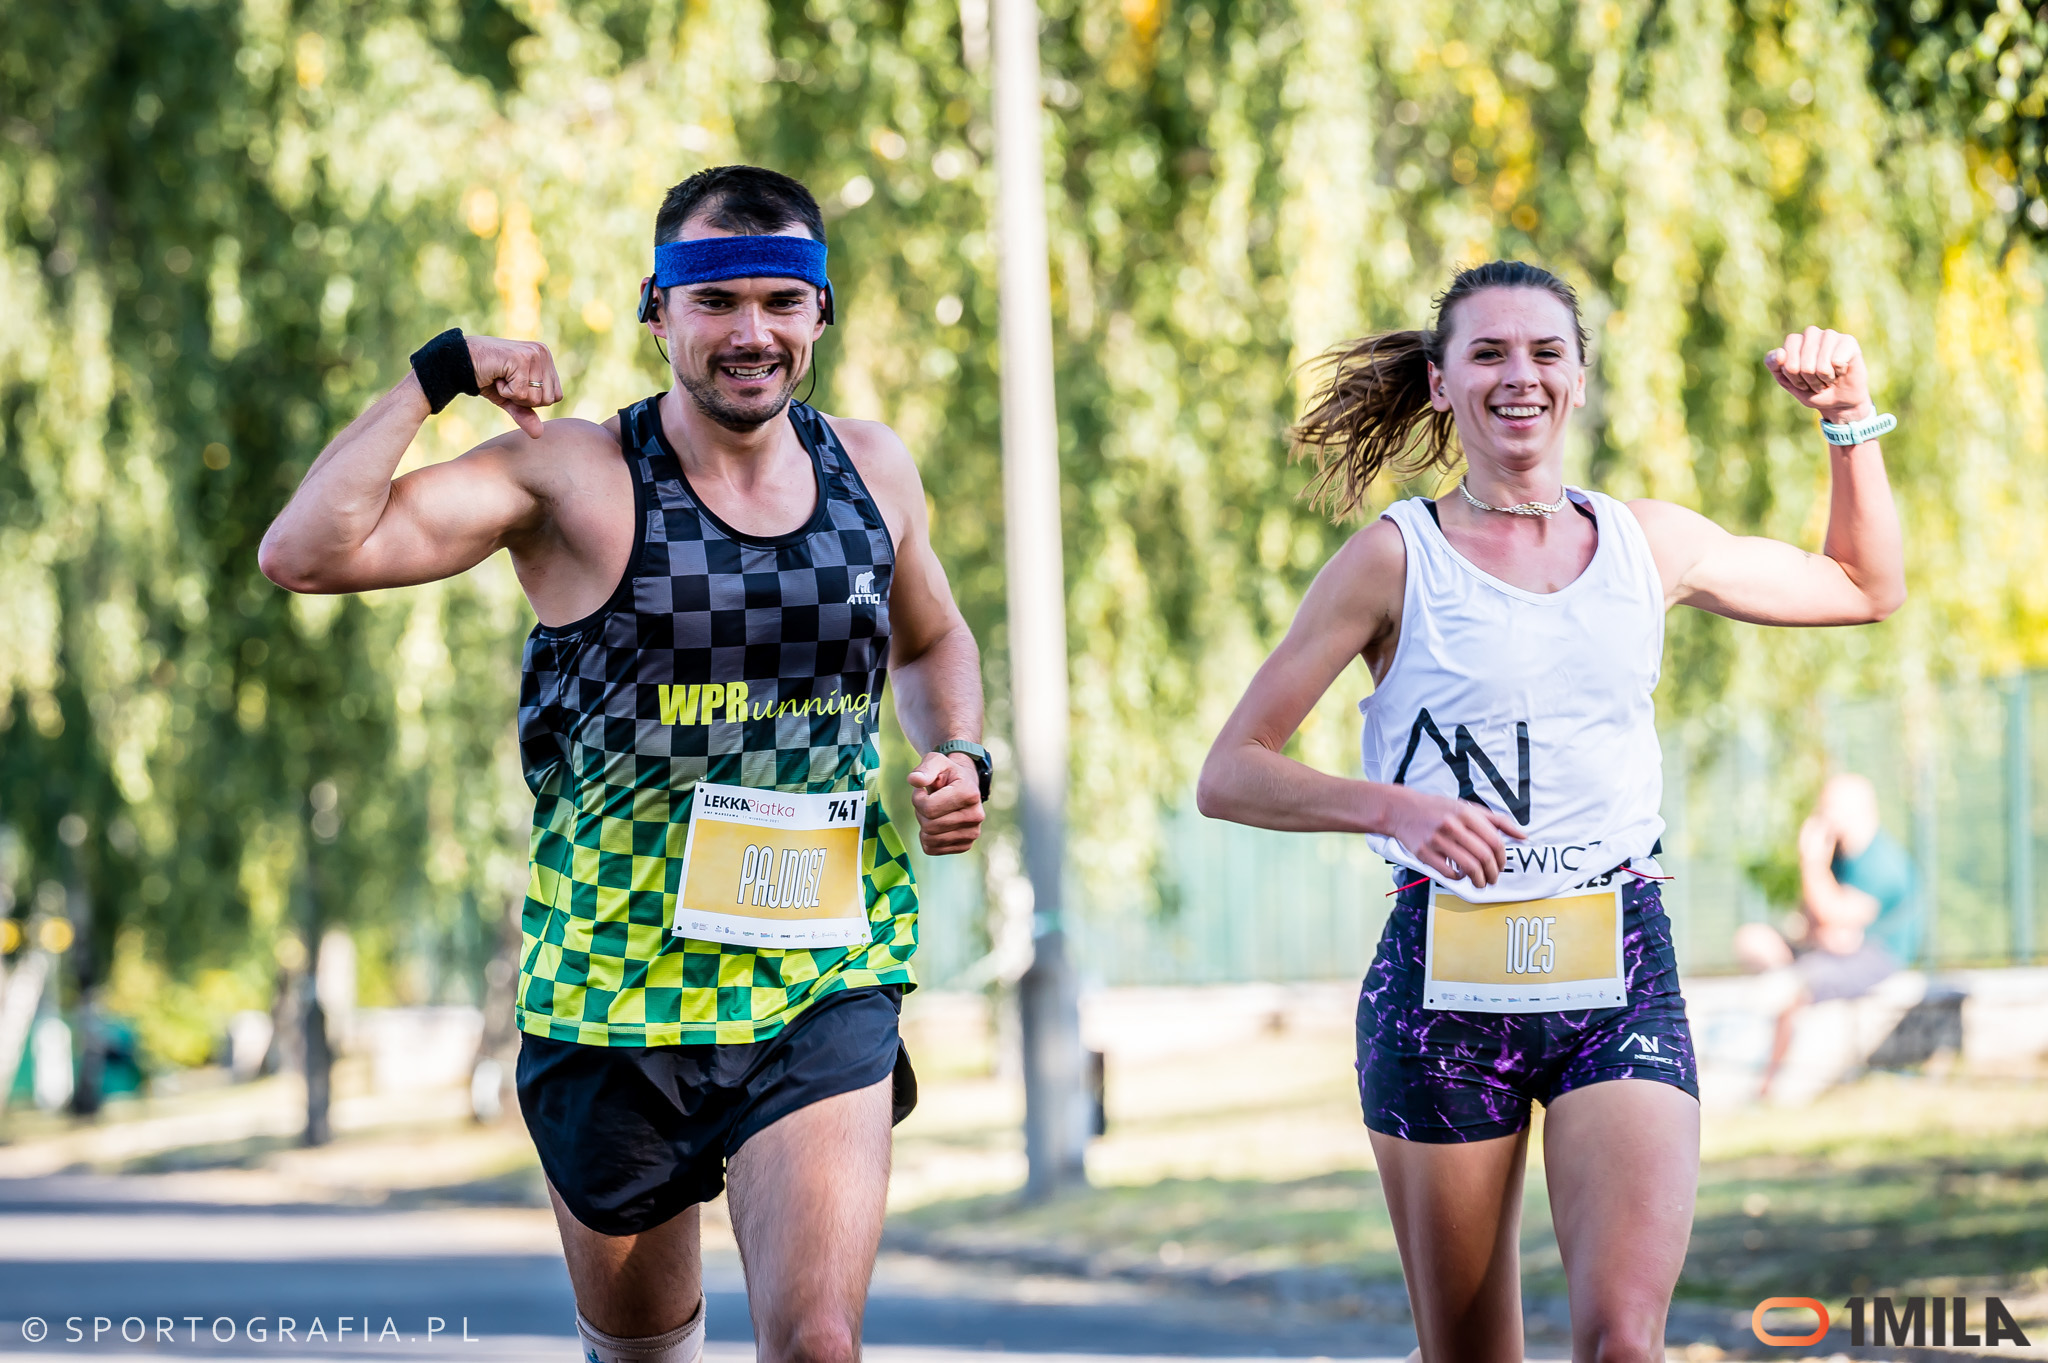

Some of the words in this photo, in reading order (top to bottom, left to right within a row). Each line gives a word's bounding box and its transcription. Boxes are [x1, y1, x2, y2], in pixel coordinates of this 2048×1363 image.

[847, 593, 880, 605] ATTIQ
[658, 681, 872, 725] WPRunning
[828, 800, 857, 822] 741
[737, 844, 827, 909] PAJDOSZ
[1505, 916, 1556, 974] 1025
